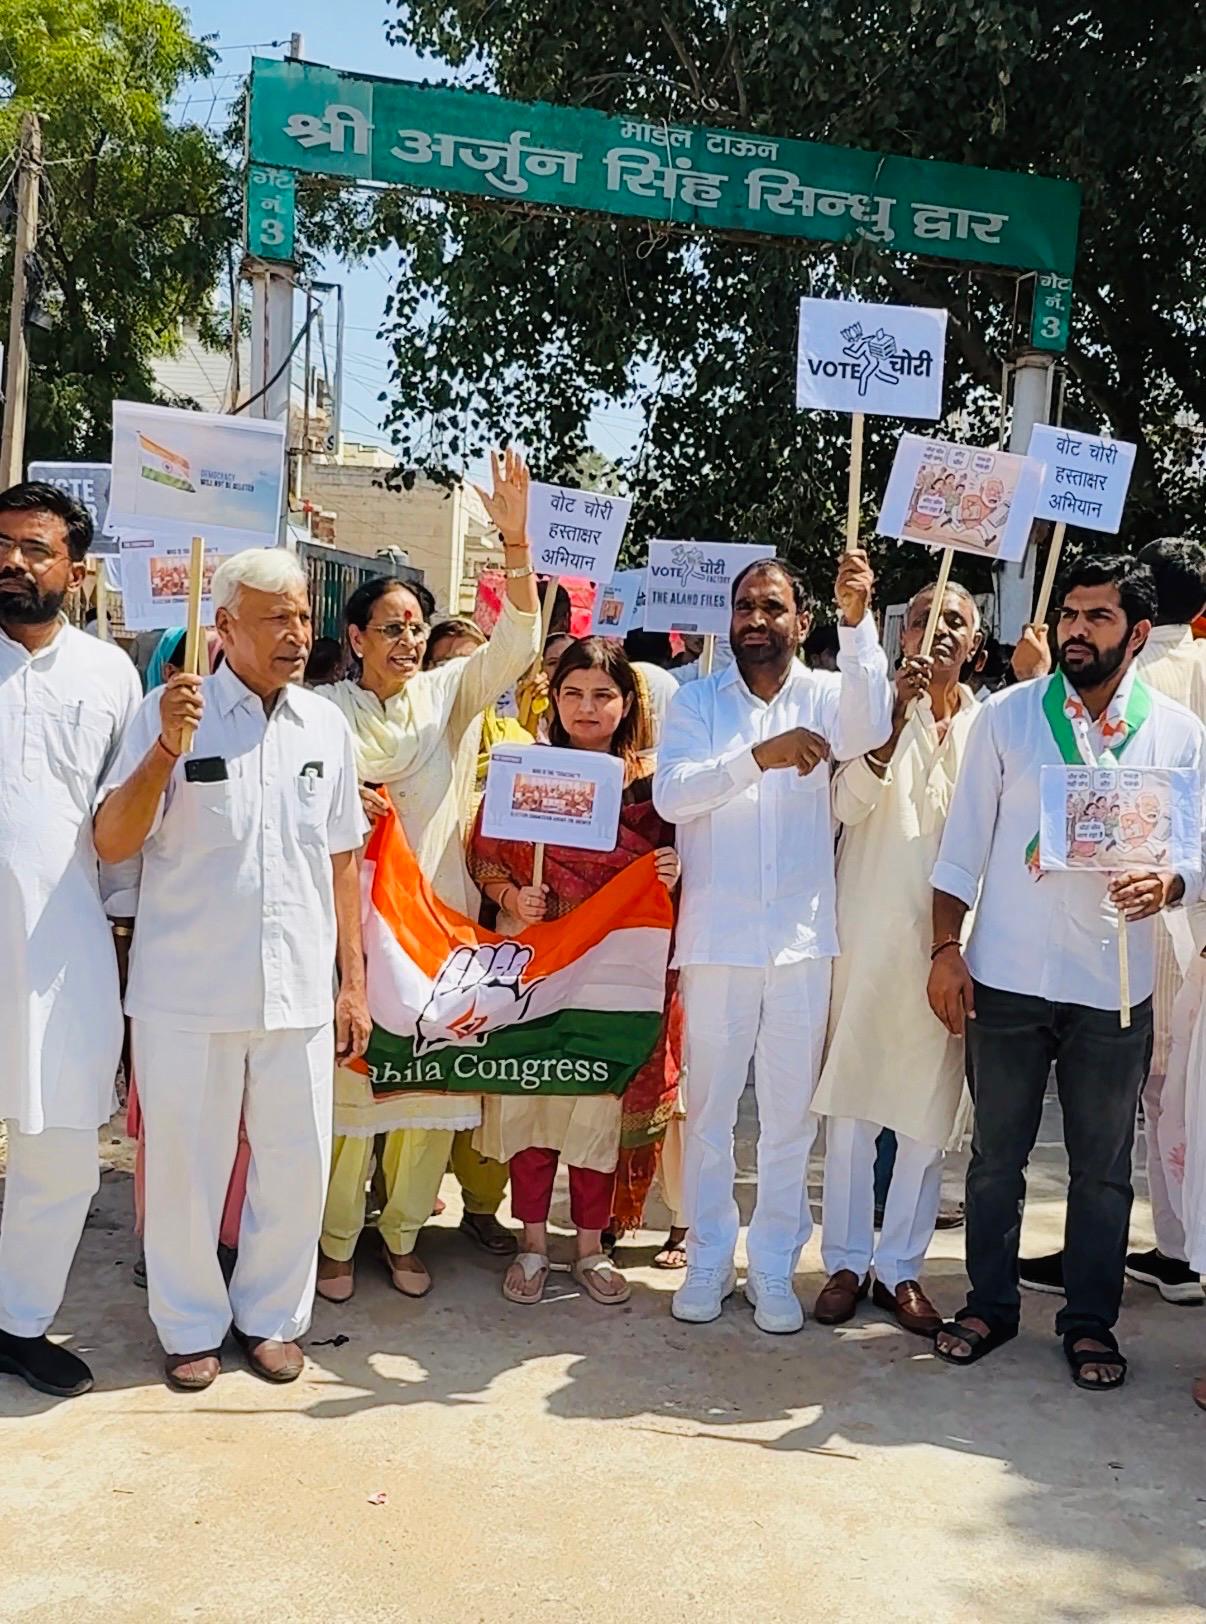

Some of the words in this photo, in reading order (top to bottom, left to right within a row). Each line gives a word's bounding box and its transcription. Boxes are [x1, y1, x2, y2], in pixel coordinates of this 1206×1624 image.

[706, 132, 779, 161] टाऊन
[282, 104, 374, 155] श्री
[390, 128, 583, 195] अर्जुन
[602, 147, 728, 209] सिंह
[744, 166, 896, 243] सिन्धु
[911, 202, 1008, 243] द्वार
[260, 218, 285, 245] 3
[1040, 272, 1072, 290] गेट
[1040, 316, 1061, 338] 3
[808, 359, 861, 380] VOTE
[889, 348, 934, 378] चोरी
[1056, 433, 1082, 456] वोट
[1089, 441, 1118, 465] चोरी
[1055, 466, 1108, 491] हस्ताक्षर
[551, 490, 576, 513] वोट
[584, 496, 613, 520] चोरी
[1049, 491, 1102, 518] अभियान
[549, 522, 602, 545] हस्ताक्षर
[541, 546, 596, 571] अभियान
[651, 565, 682, 578] VOTE
[652, 591, 669, 605] THE
[700, 594, 726, 608] FILES
[453, 1053, 609, 1089] Congress
